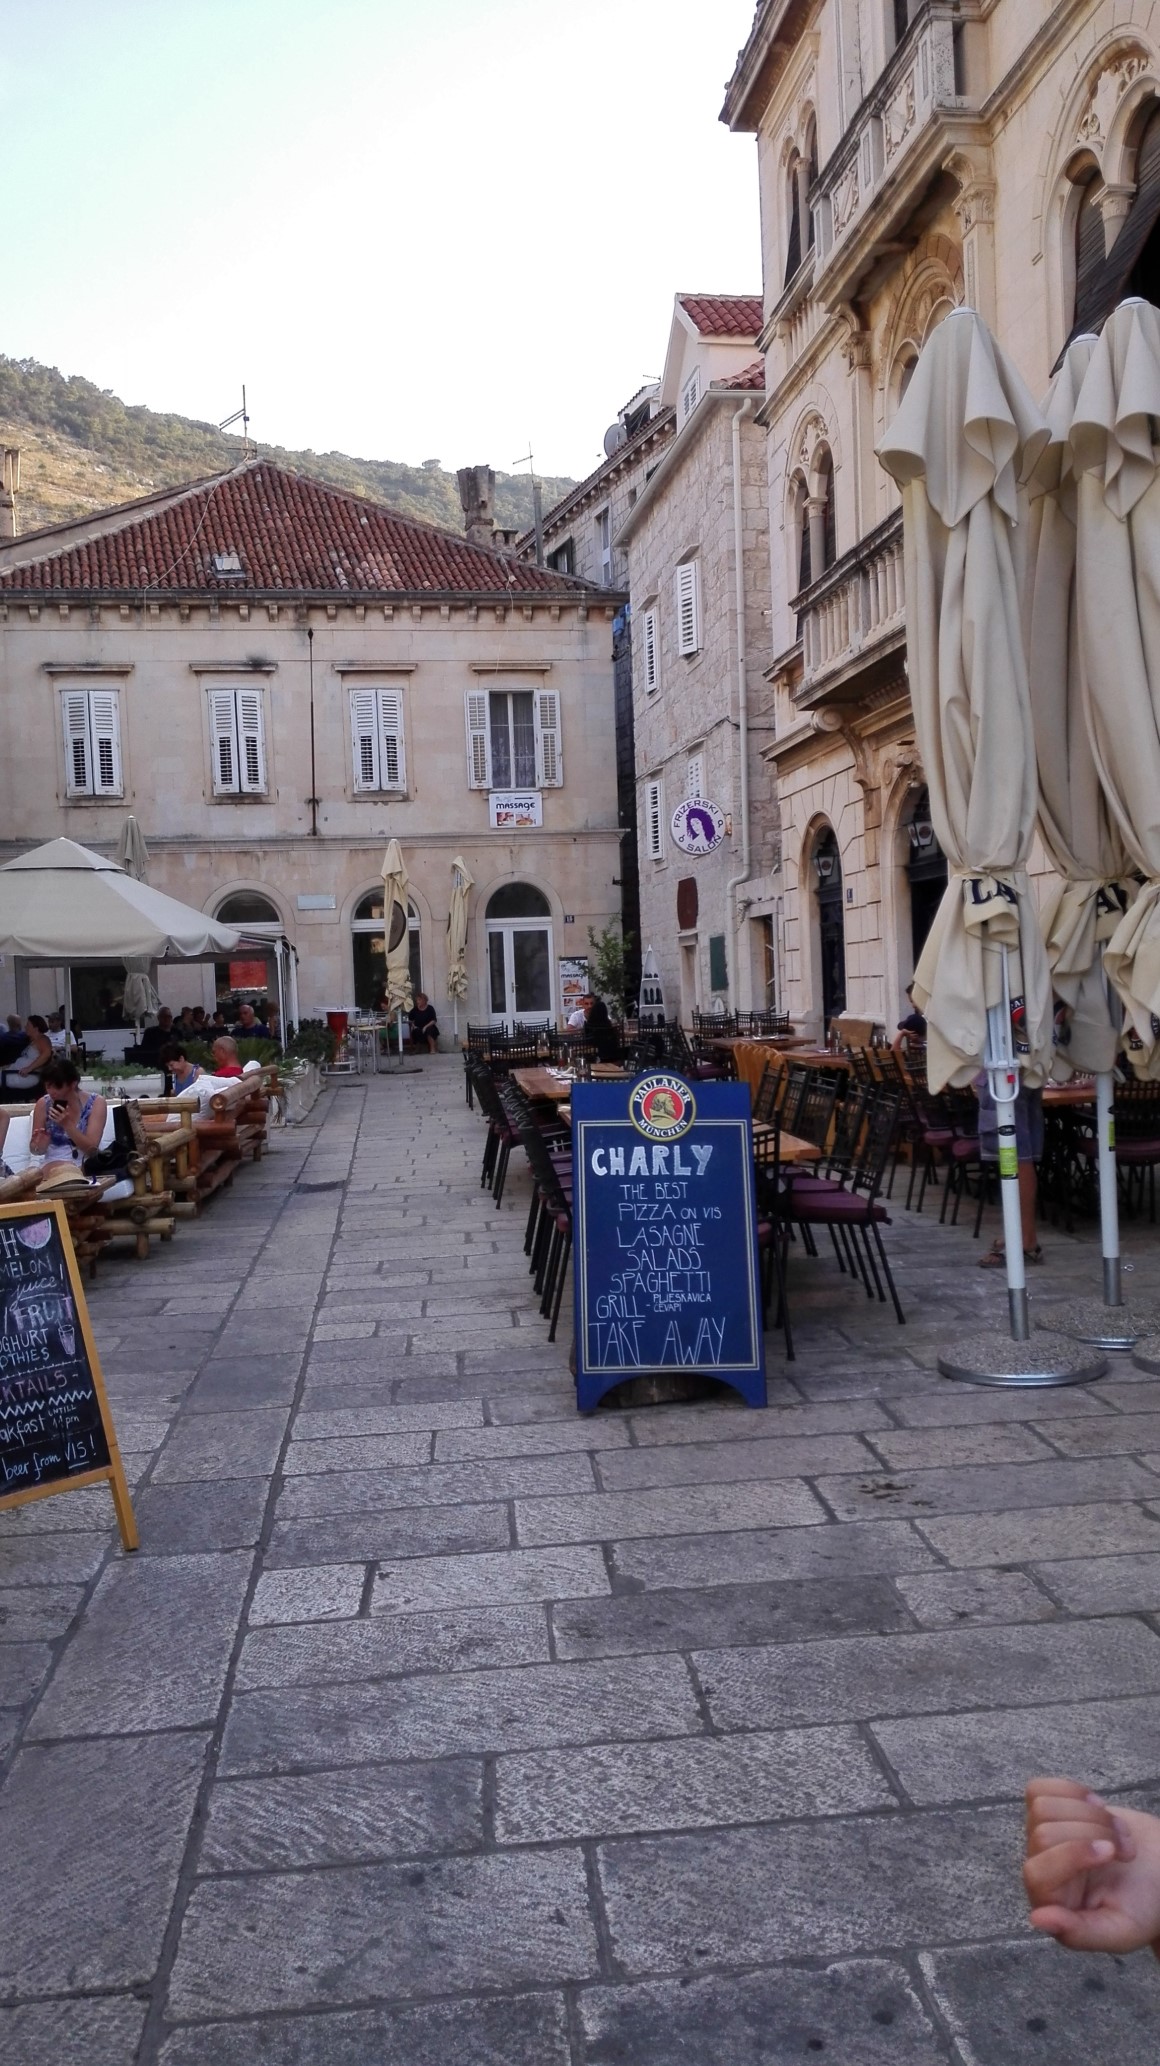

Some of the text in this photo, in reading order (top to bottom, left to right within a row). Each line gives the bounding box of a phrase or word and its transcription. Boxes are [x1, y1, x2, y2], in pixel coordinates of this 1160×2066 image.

[673, 799, 719, 828] FRIZERSKI
[686, 834, 722, 853] SALON
[634, 1078, 691, 1104] PAULANER
[591, 1145, 713, 1176] CHARLY
[619, 1181, 688, 1200] THE BEST
[618, 1202, 722, 1221] PIZZA ON VIS
[616, 1223, 705, 1248] LASAGNE
[625, 1247, 702, 1271] SALADS
[609, 1271, 711, 1294] SPAGHETTI
[596, 1295, 646, 1319] GRILL
[653, 1293, 712, 1303] PLJESKAVICA
[588, 1316, 726, 1367] TAKE AWAY
[0, 1370, 68, 1405] KTAILS
[65, 1415, 80, 1430] pm
[1, 1456, 30, 1481] beer
[33, 1451, 61, 1481] from
